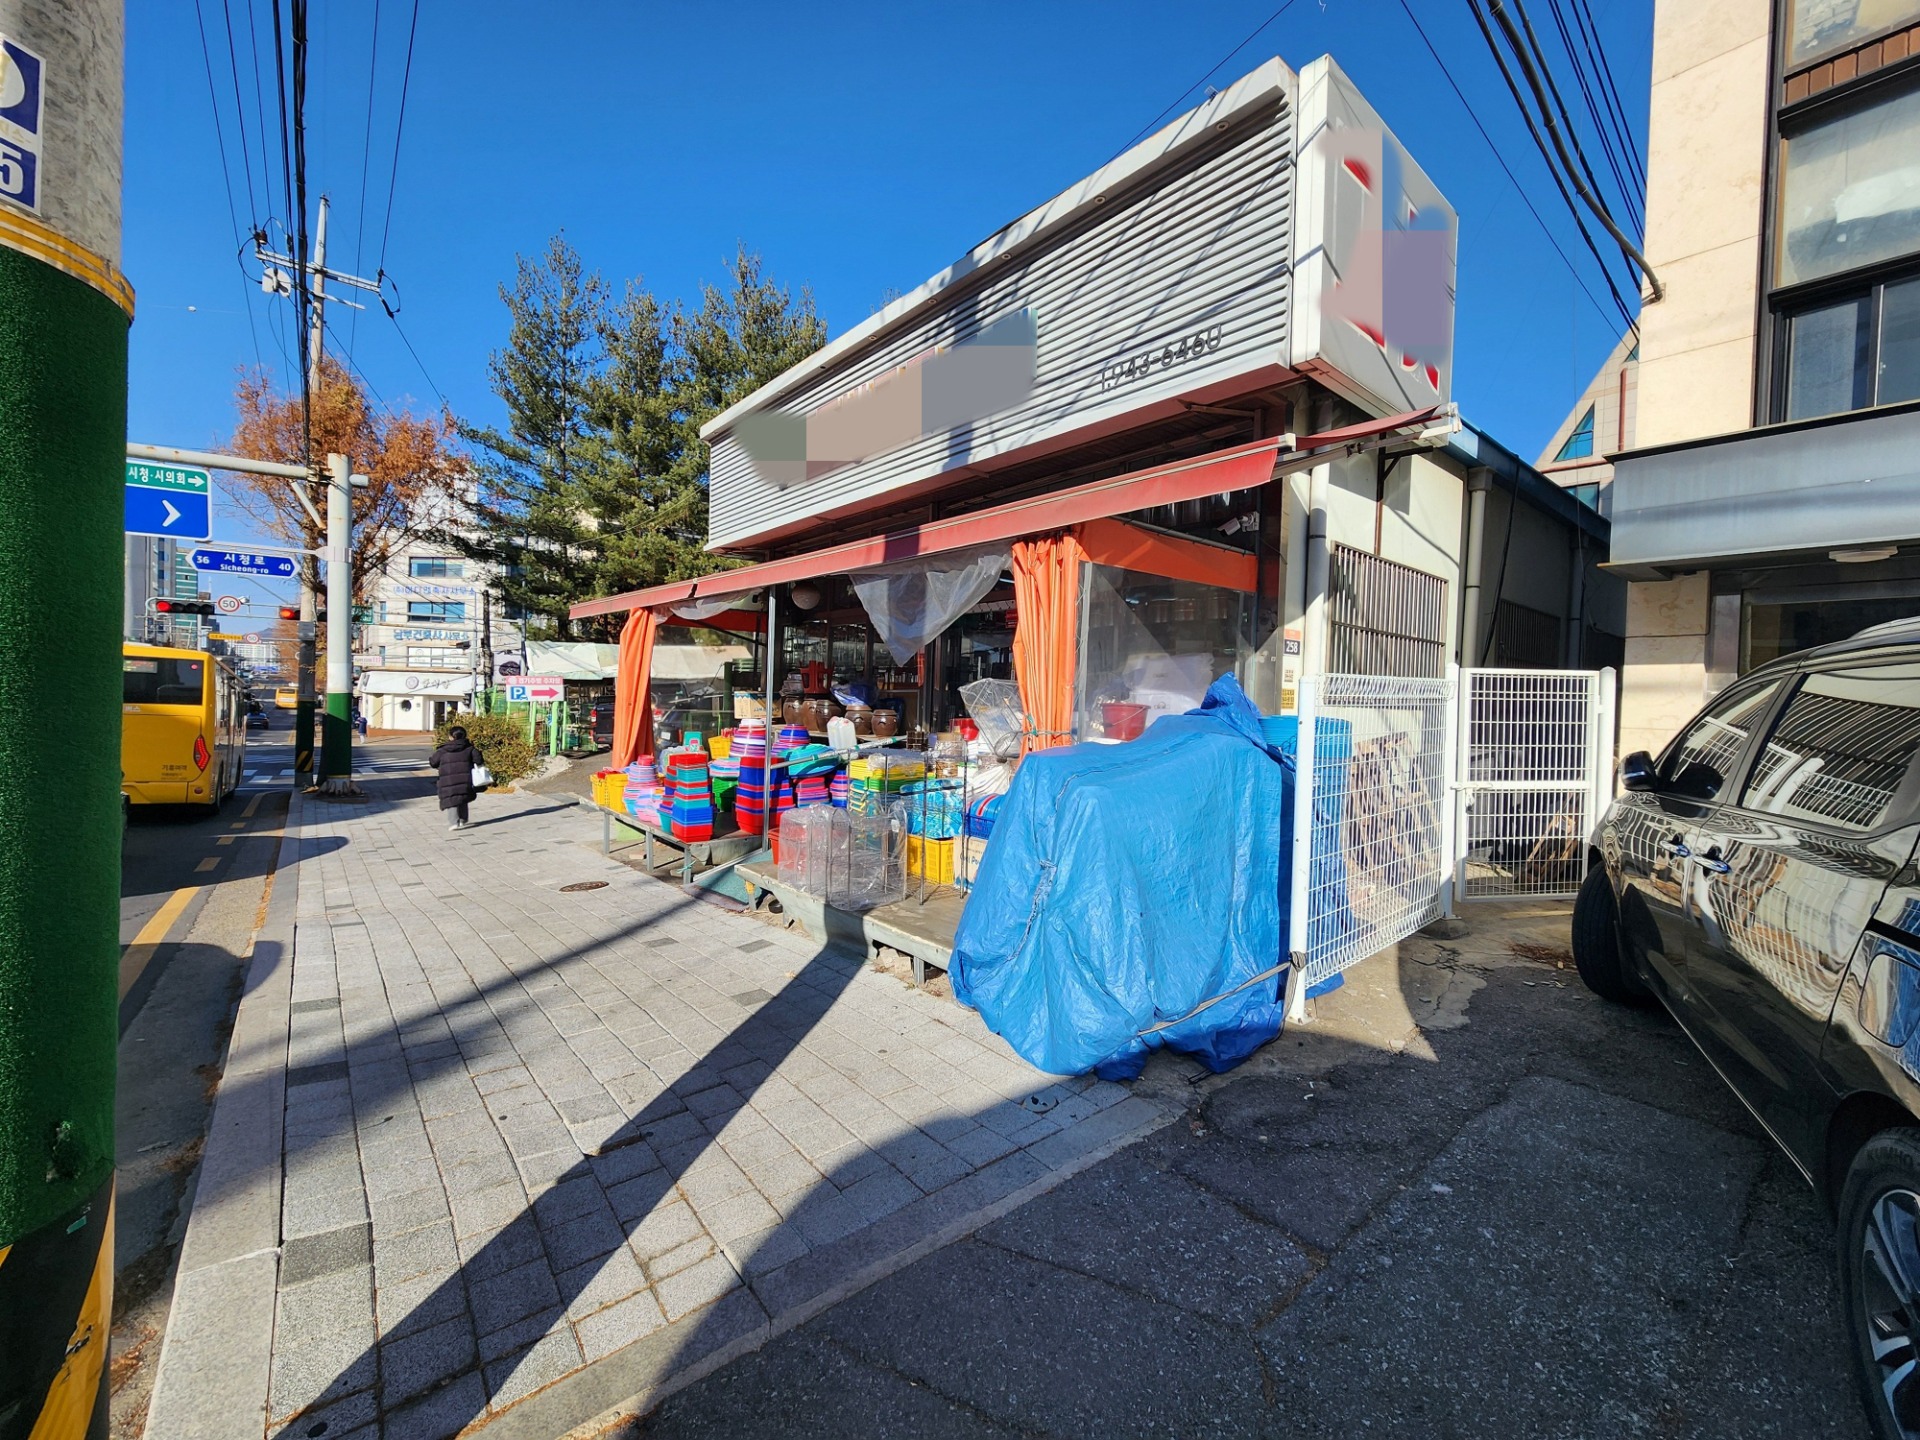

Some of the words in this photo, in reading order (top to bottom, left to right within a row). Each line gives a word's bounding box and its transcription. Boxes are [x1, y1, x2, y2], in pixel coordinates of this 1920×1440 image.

[128, 466, 186, 485] 시청·시의회
[196, 555, 210, 564] 36
[224, 553, 266, 566] 시청로
[278, 563, 291, 571] 40
[220, 563, 269, 574] Sicheong-ro
[222, 600, 236, 608] 50
[1286, 641, 1299, 653] 258
[513, 687, 523, 699] P
